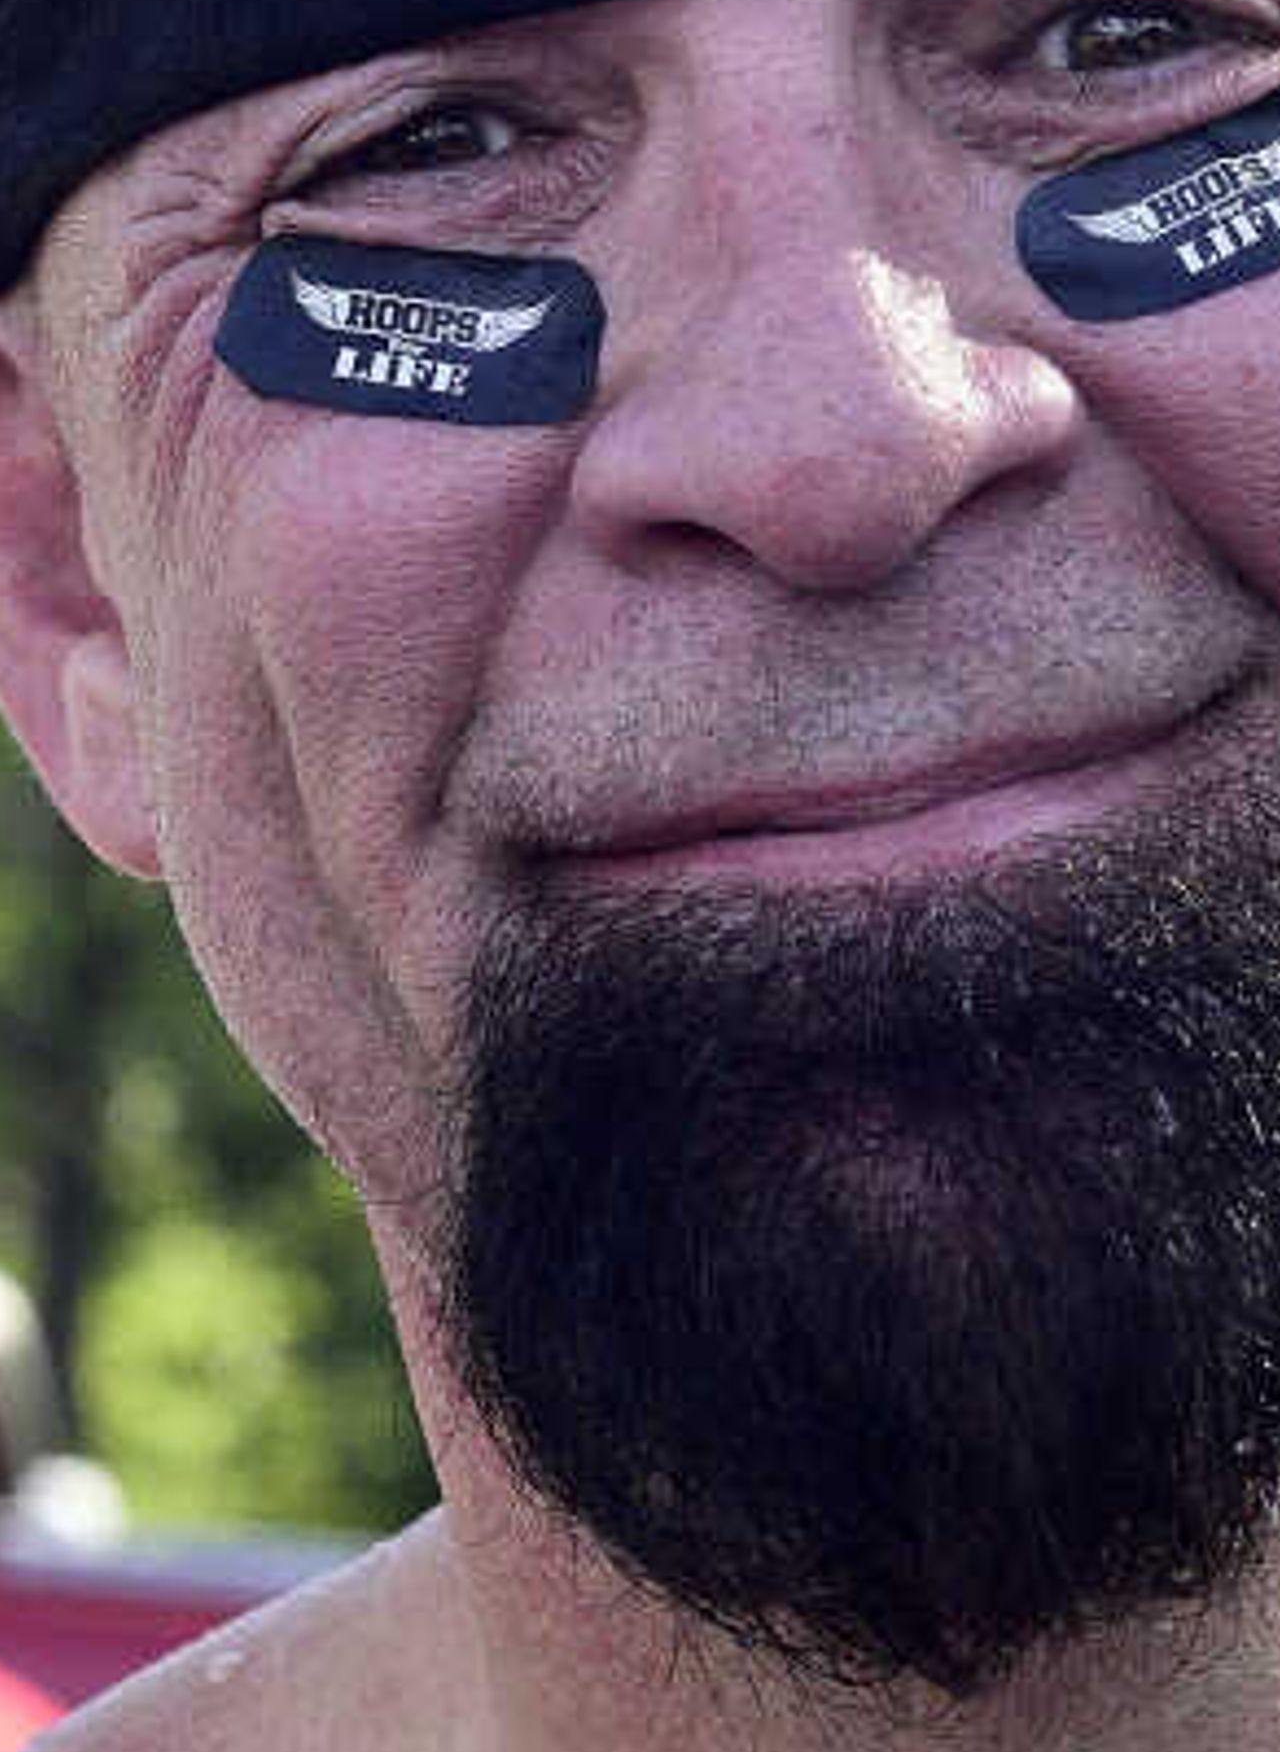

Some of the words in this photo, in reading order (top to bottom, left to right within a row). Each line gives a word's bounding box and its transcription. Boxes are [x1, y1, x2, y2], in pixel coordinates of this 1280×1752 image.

[1144, 156, 1271, 228] HOOPS
[345, 292, 482, 344] HOOPS
[331, 346, 474, 396] LIFE
